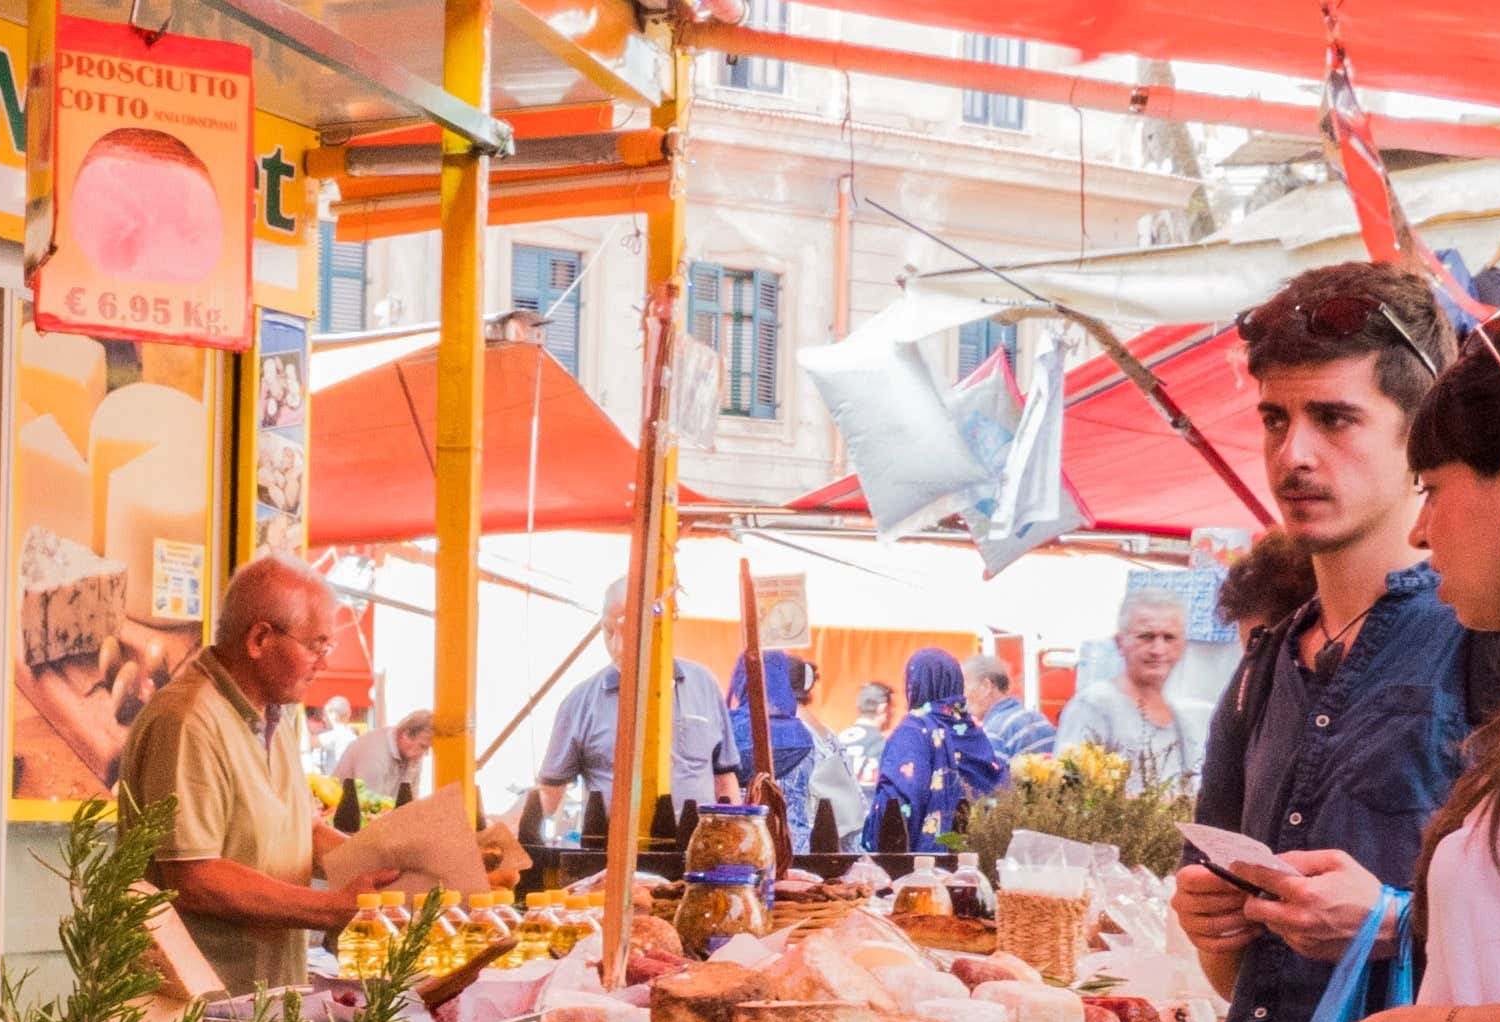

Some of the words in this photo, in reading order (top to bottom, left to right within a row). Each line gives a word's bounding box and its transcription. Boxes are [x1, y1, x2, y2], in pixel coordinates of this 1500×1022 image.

[57, 52, 238, 101] PROSCIUTTO
[58, 87, 149, 120] COTTO
[65, 287, 87, 318] €
[182, 299, 229, 337] Kg.
